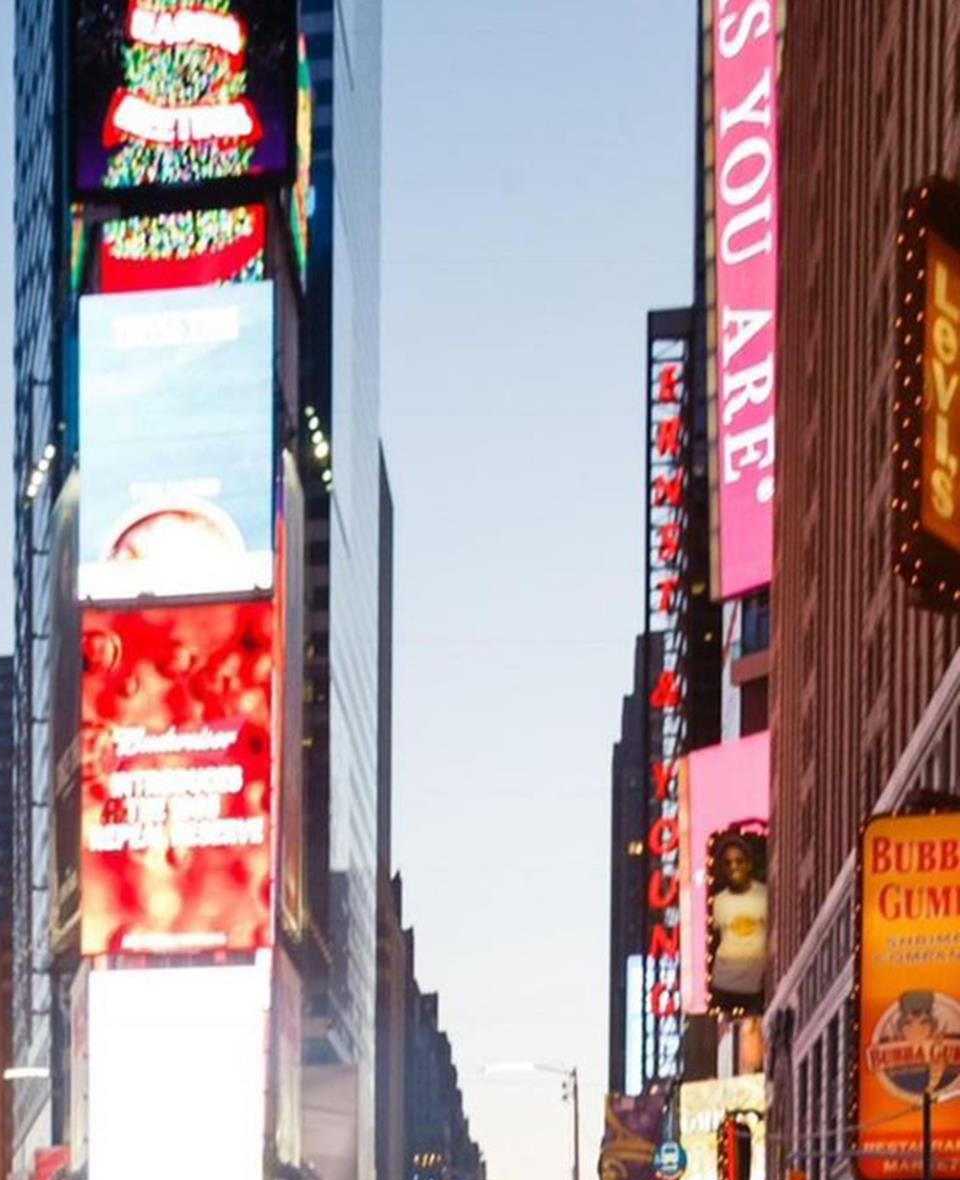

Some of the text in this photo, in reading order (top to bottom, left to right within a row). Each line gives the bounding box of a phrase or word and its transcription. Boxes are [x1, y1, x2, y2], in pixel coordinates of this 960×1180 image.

[720, 66, 773, 266] YOU
[649, 669, 681, 709] &
[648, 760, 679, 1018] YOUNG
[878, 883, 960, 921] GUM
